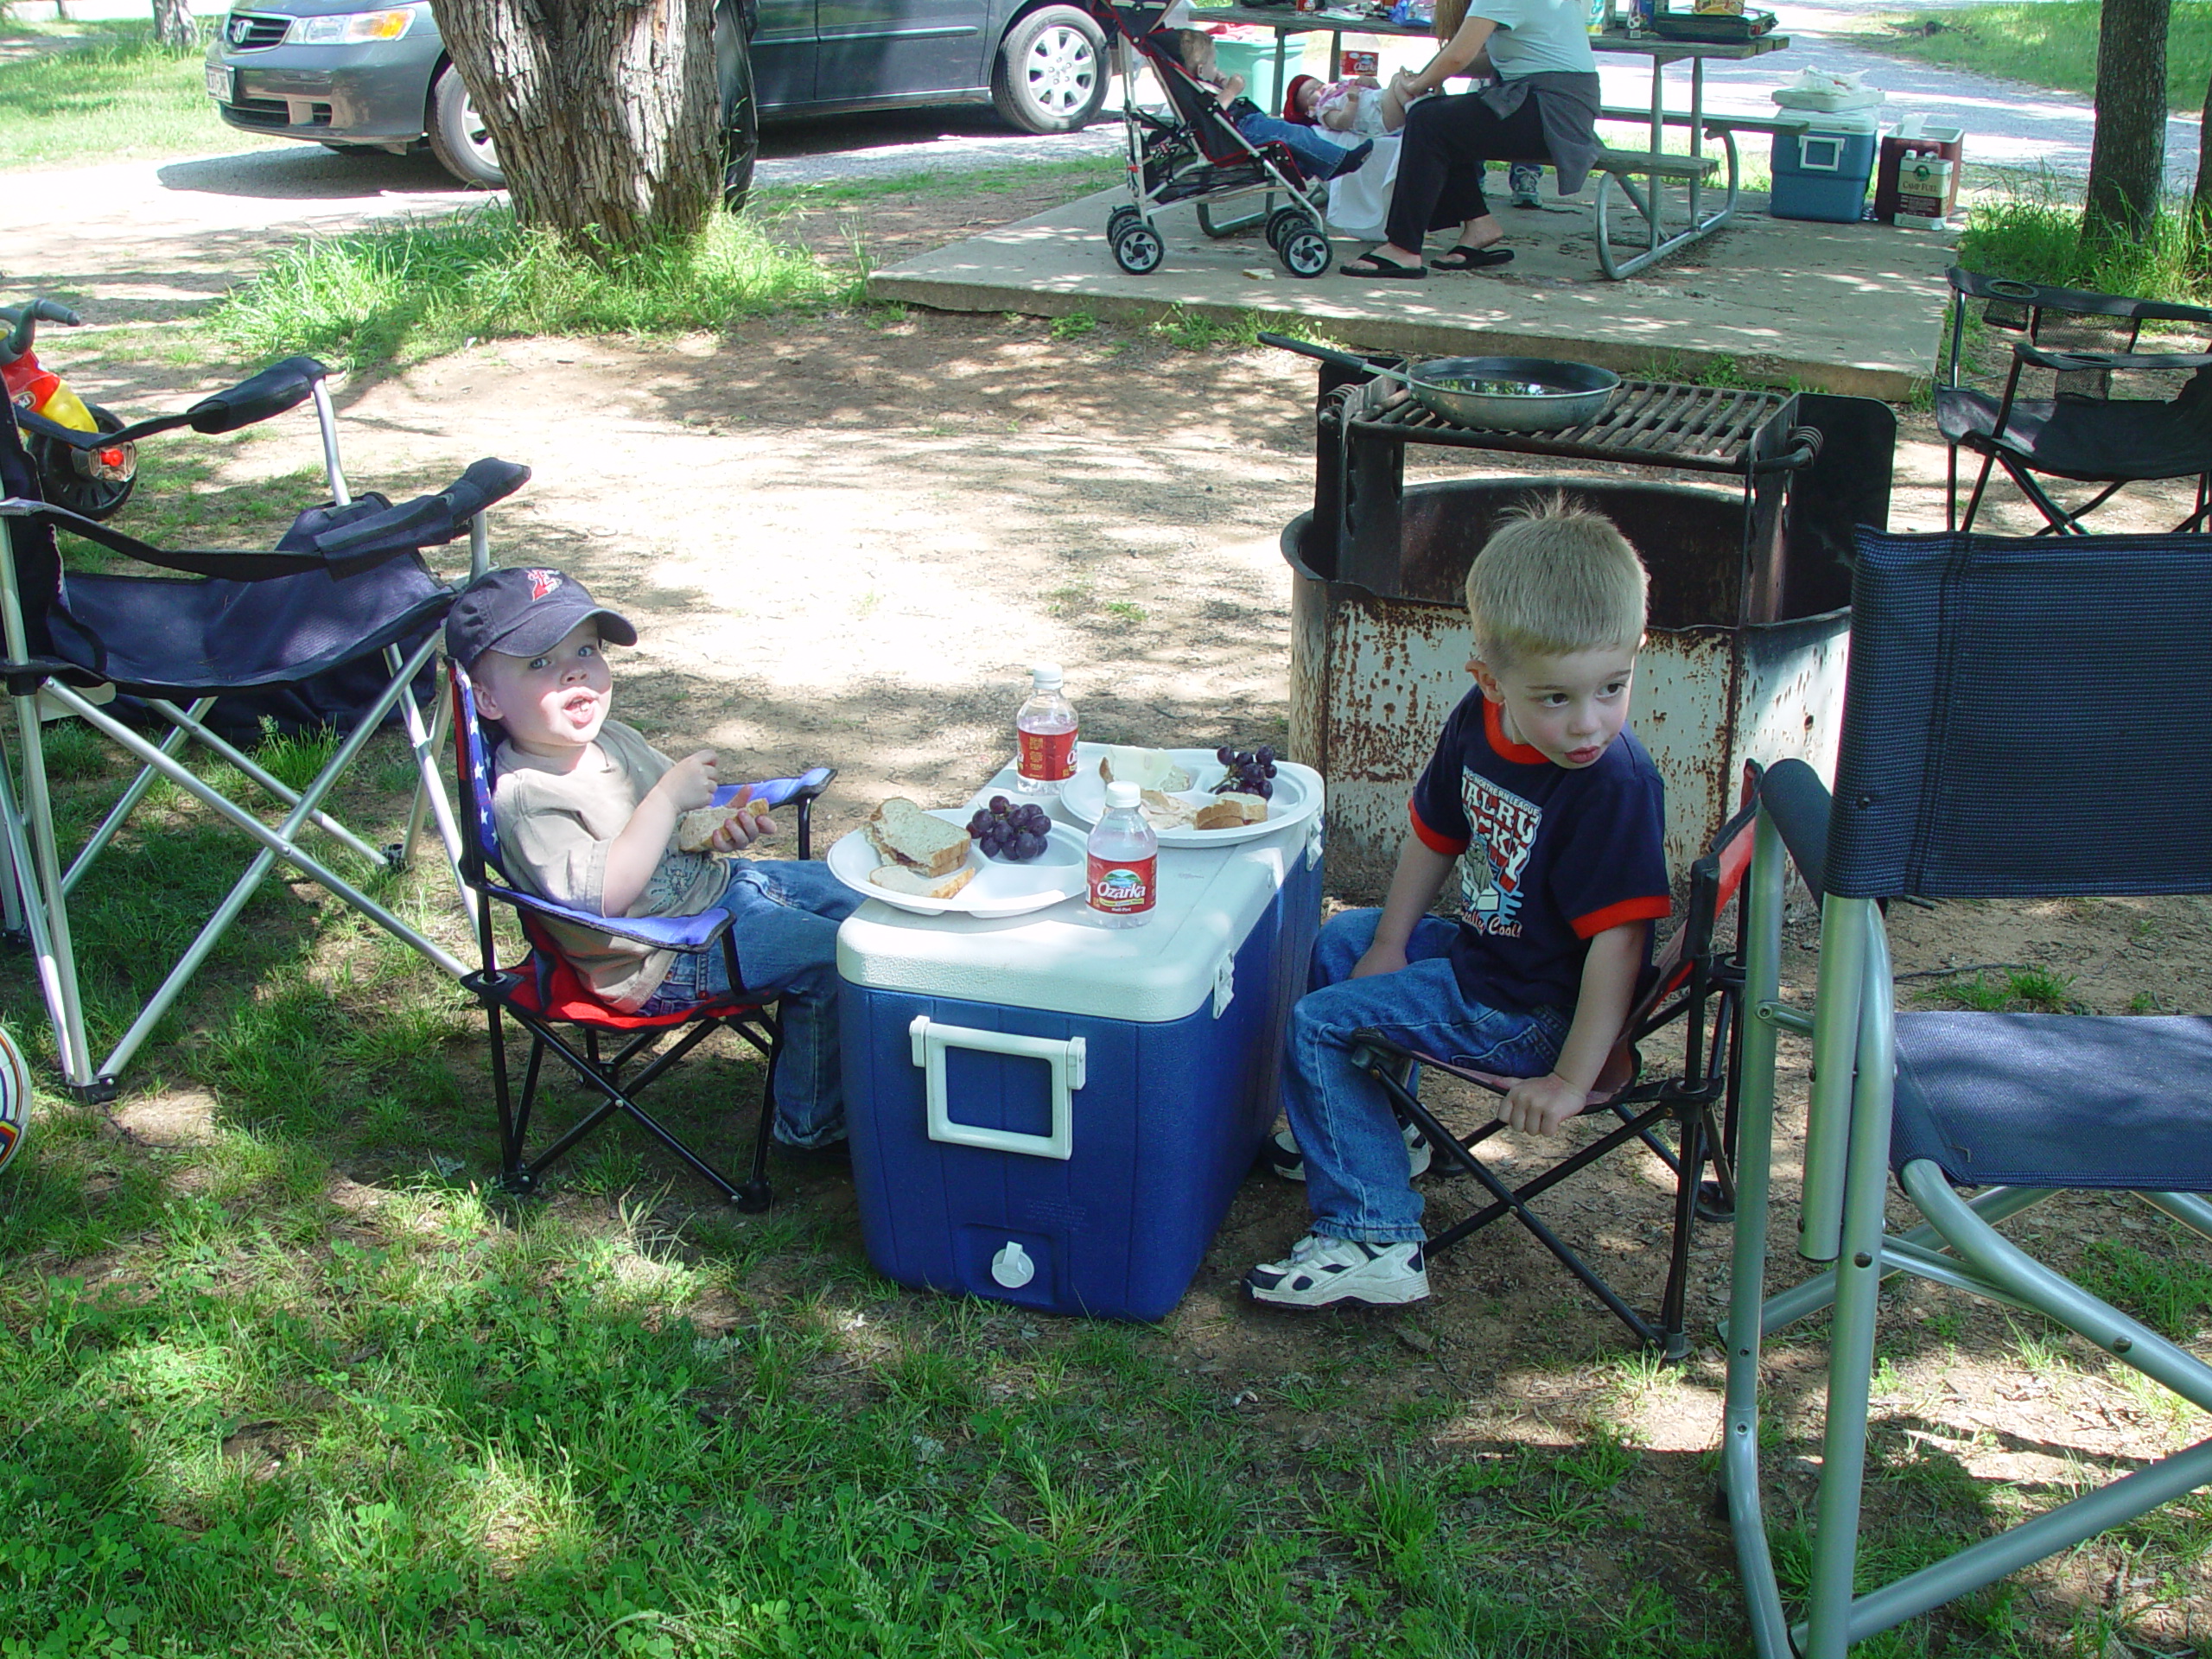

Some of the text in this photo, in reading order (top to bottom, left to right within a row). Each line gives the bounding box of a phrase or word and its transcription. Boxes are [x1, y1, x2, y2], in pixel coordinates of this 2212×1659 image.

[1903, 181, 1921, 190] CAMP
[1921, 182, 1939, 193] FUEL
[1510, 794, 1540, 817] LEAGUE
[1096, 881, 1147, 899] Ozarka
